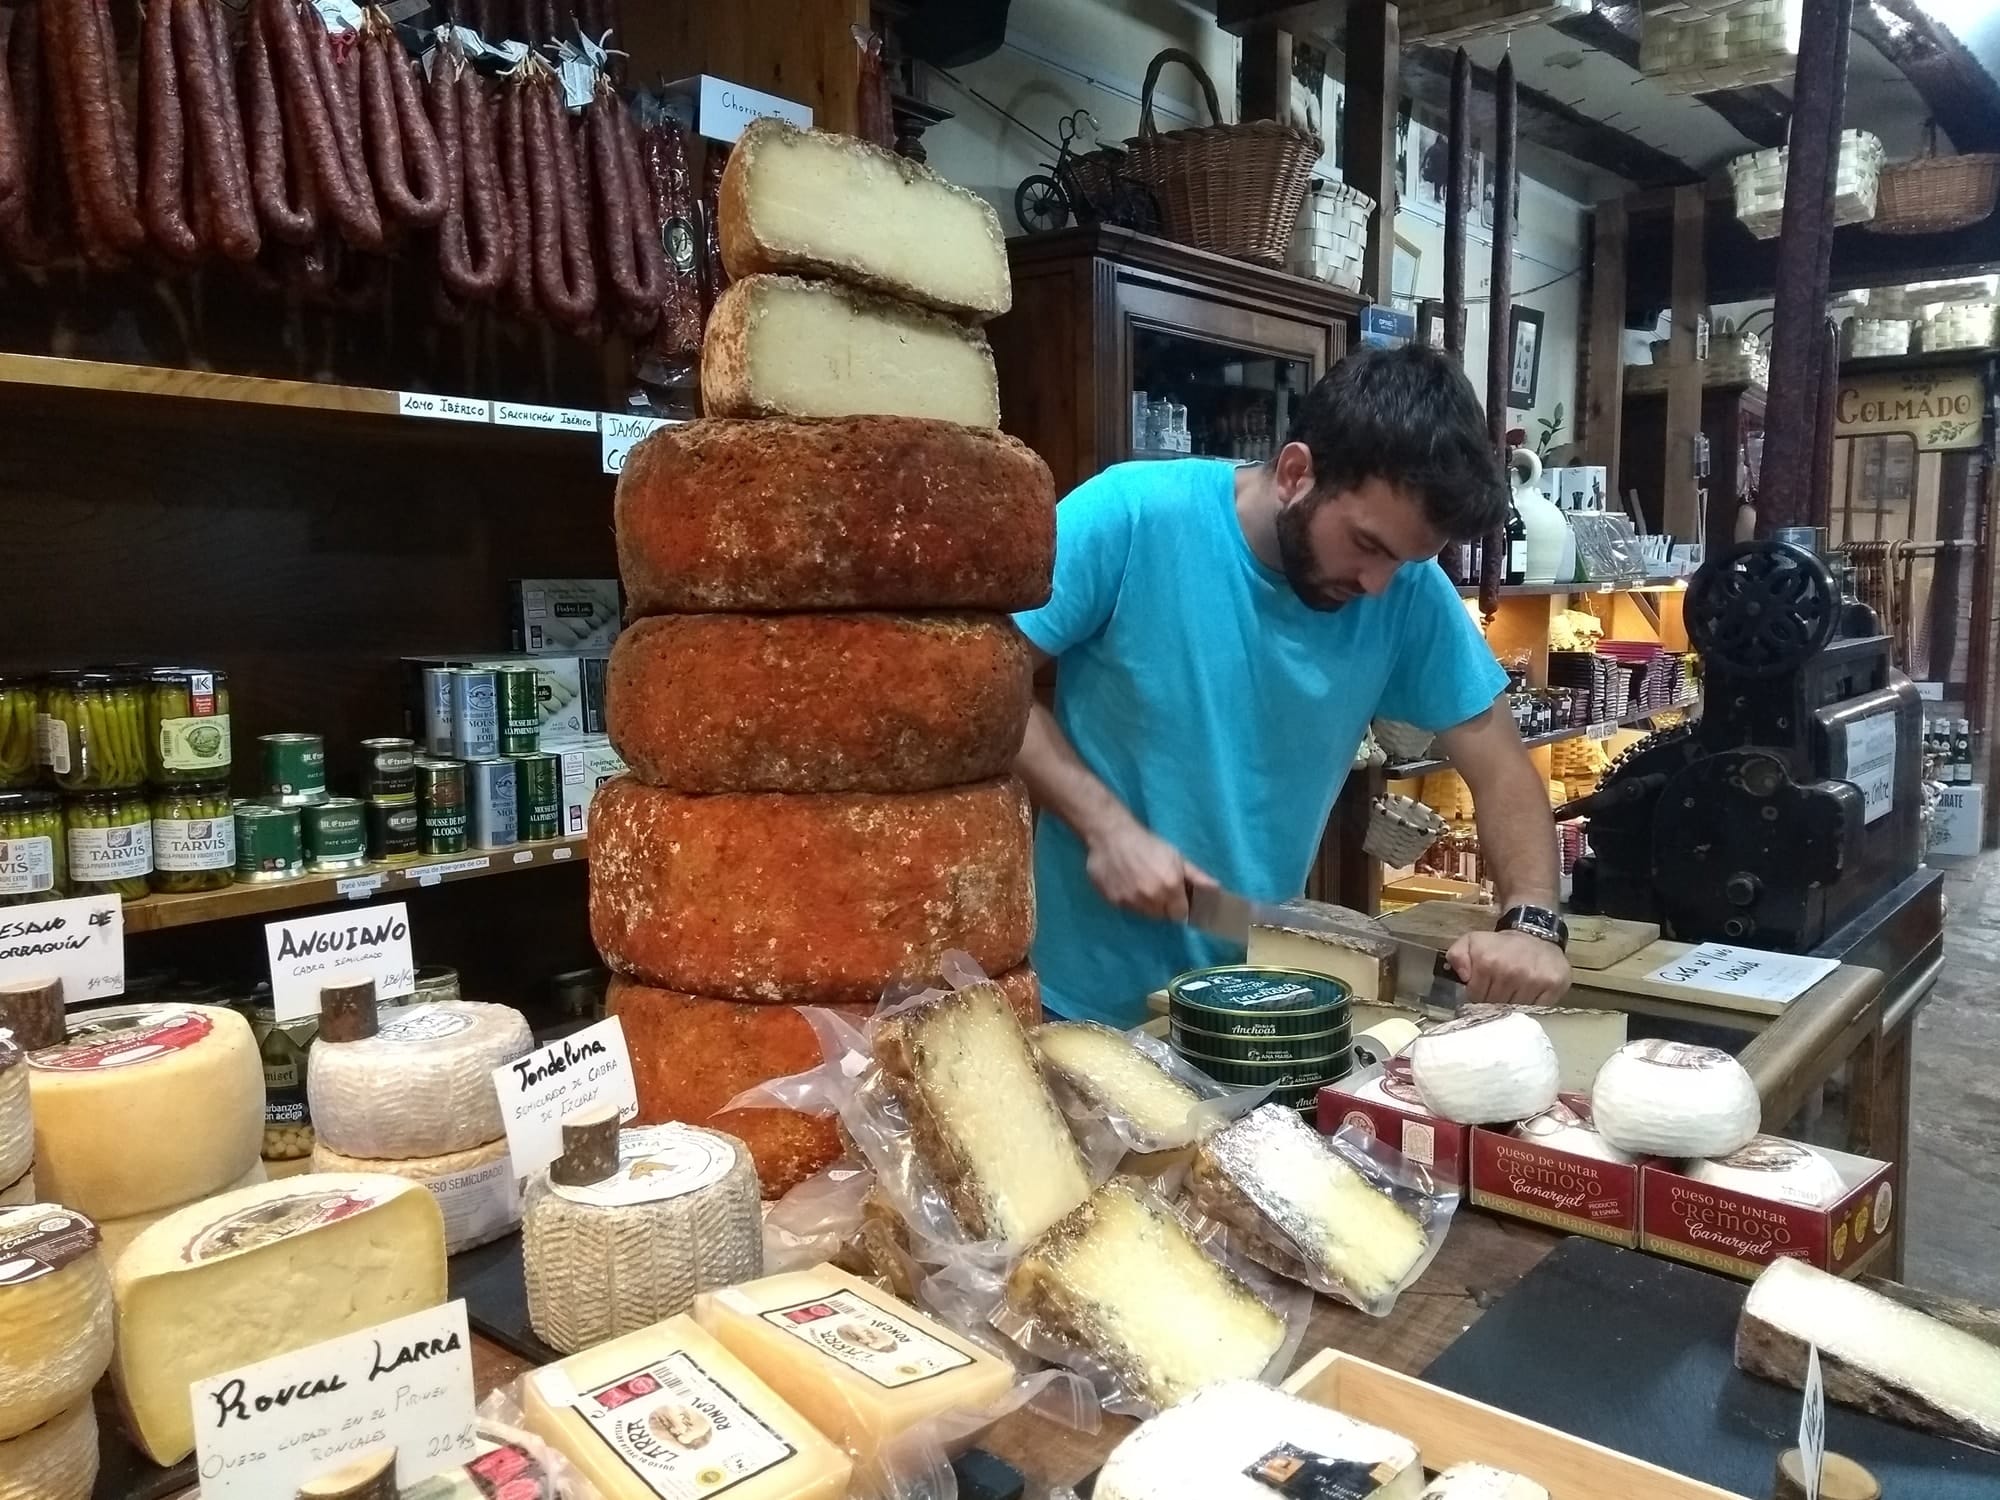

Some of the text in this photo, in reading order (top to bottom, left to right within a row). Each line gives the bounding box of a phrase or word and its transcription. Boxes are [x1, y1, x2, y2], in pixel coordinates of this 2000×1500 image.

[89, 846, 146, 861] TARVIS
[171, 839, 226, 852] TARVIS
[357, 878, 377, 888] Vasco
[88, 910, 116, 927] DE
[277, 916, 407, 962] ANGUIANO
[292, 963, 326, 977] CABRA
[1231, 1024, 1276, 1035] Anchoas
[512, 1040, 606, 1092] Tondeluna
[588, 1059, 618, 1082] CABRA
[275, 1110, 303, 1121] acelga
[448, 1164, 504, 1191] SEMICURADO
[1496, 1145, 1599, 1179] QUESO DE UNTAR
[1496, 1158, 1602, 1197] CREMOSO
[1508, 1174, 1586, 1209] Cañarejal
[1671, 1186, 1788, 1226] QUESO DE UNTAR
[1478, 1193, 1624, 1241] QUESOS CON TRADICIÓN
[1671, 1199, 1792, 1245] CREMOSO
[1684, 1217, 1773, 1257] Cañarejal
[1649, 1238, 1700, 1261] QUESOS
[1703, 1253, 1734, 1270] CON
[869, 1318, 912, 1344] RONCAL
[208, 1332, 462, 1428] RONCAL LARRA
[341, 1415, 363, 1431] EN
[690, 1396, 732, 1432] RONCAL
[626, 1418, 680, 1462] LARRA
